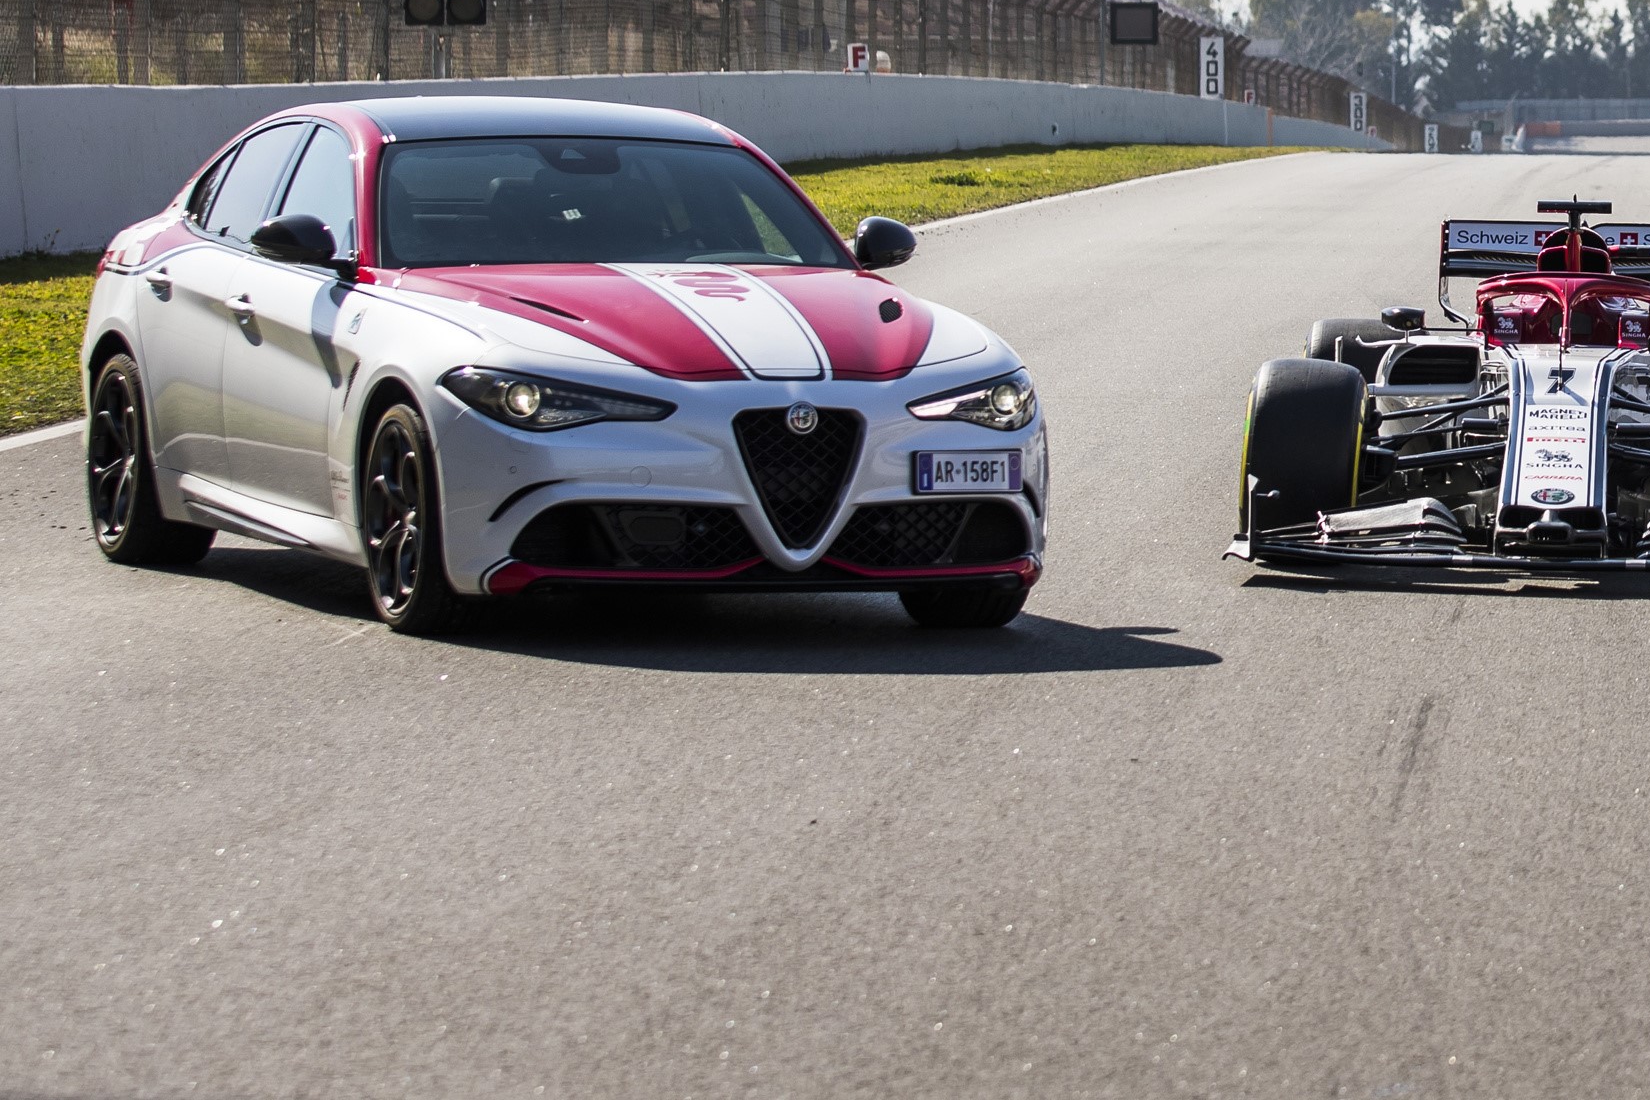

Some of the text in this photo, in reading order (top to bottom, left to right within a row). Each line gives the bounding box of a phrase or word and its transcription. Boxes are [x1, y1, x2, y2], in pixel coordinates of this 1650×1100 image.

[853, 47, 867, 69] F
[1205, 41, 1219, 95] 400
[1456, 229, 1529, 246] Schweiz
[1545, 367, 1577, 396] 7
[934, 460, 1006, 483] AR 158F1
